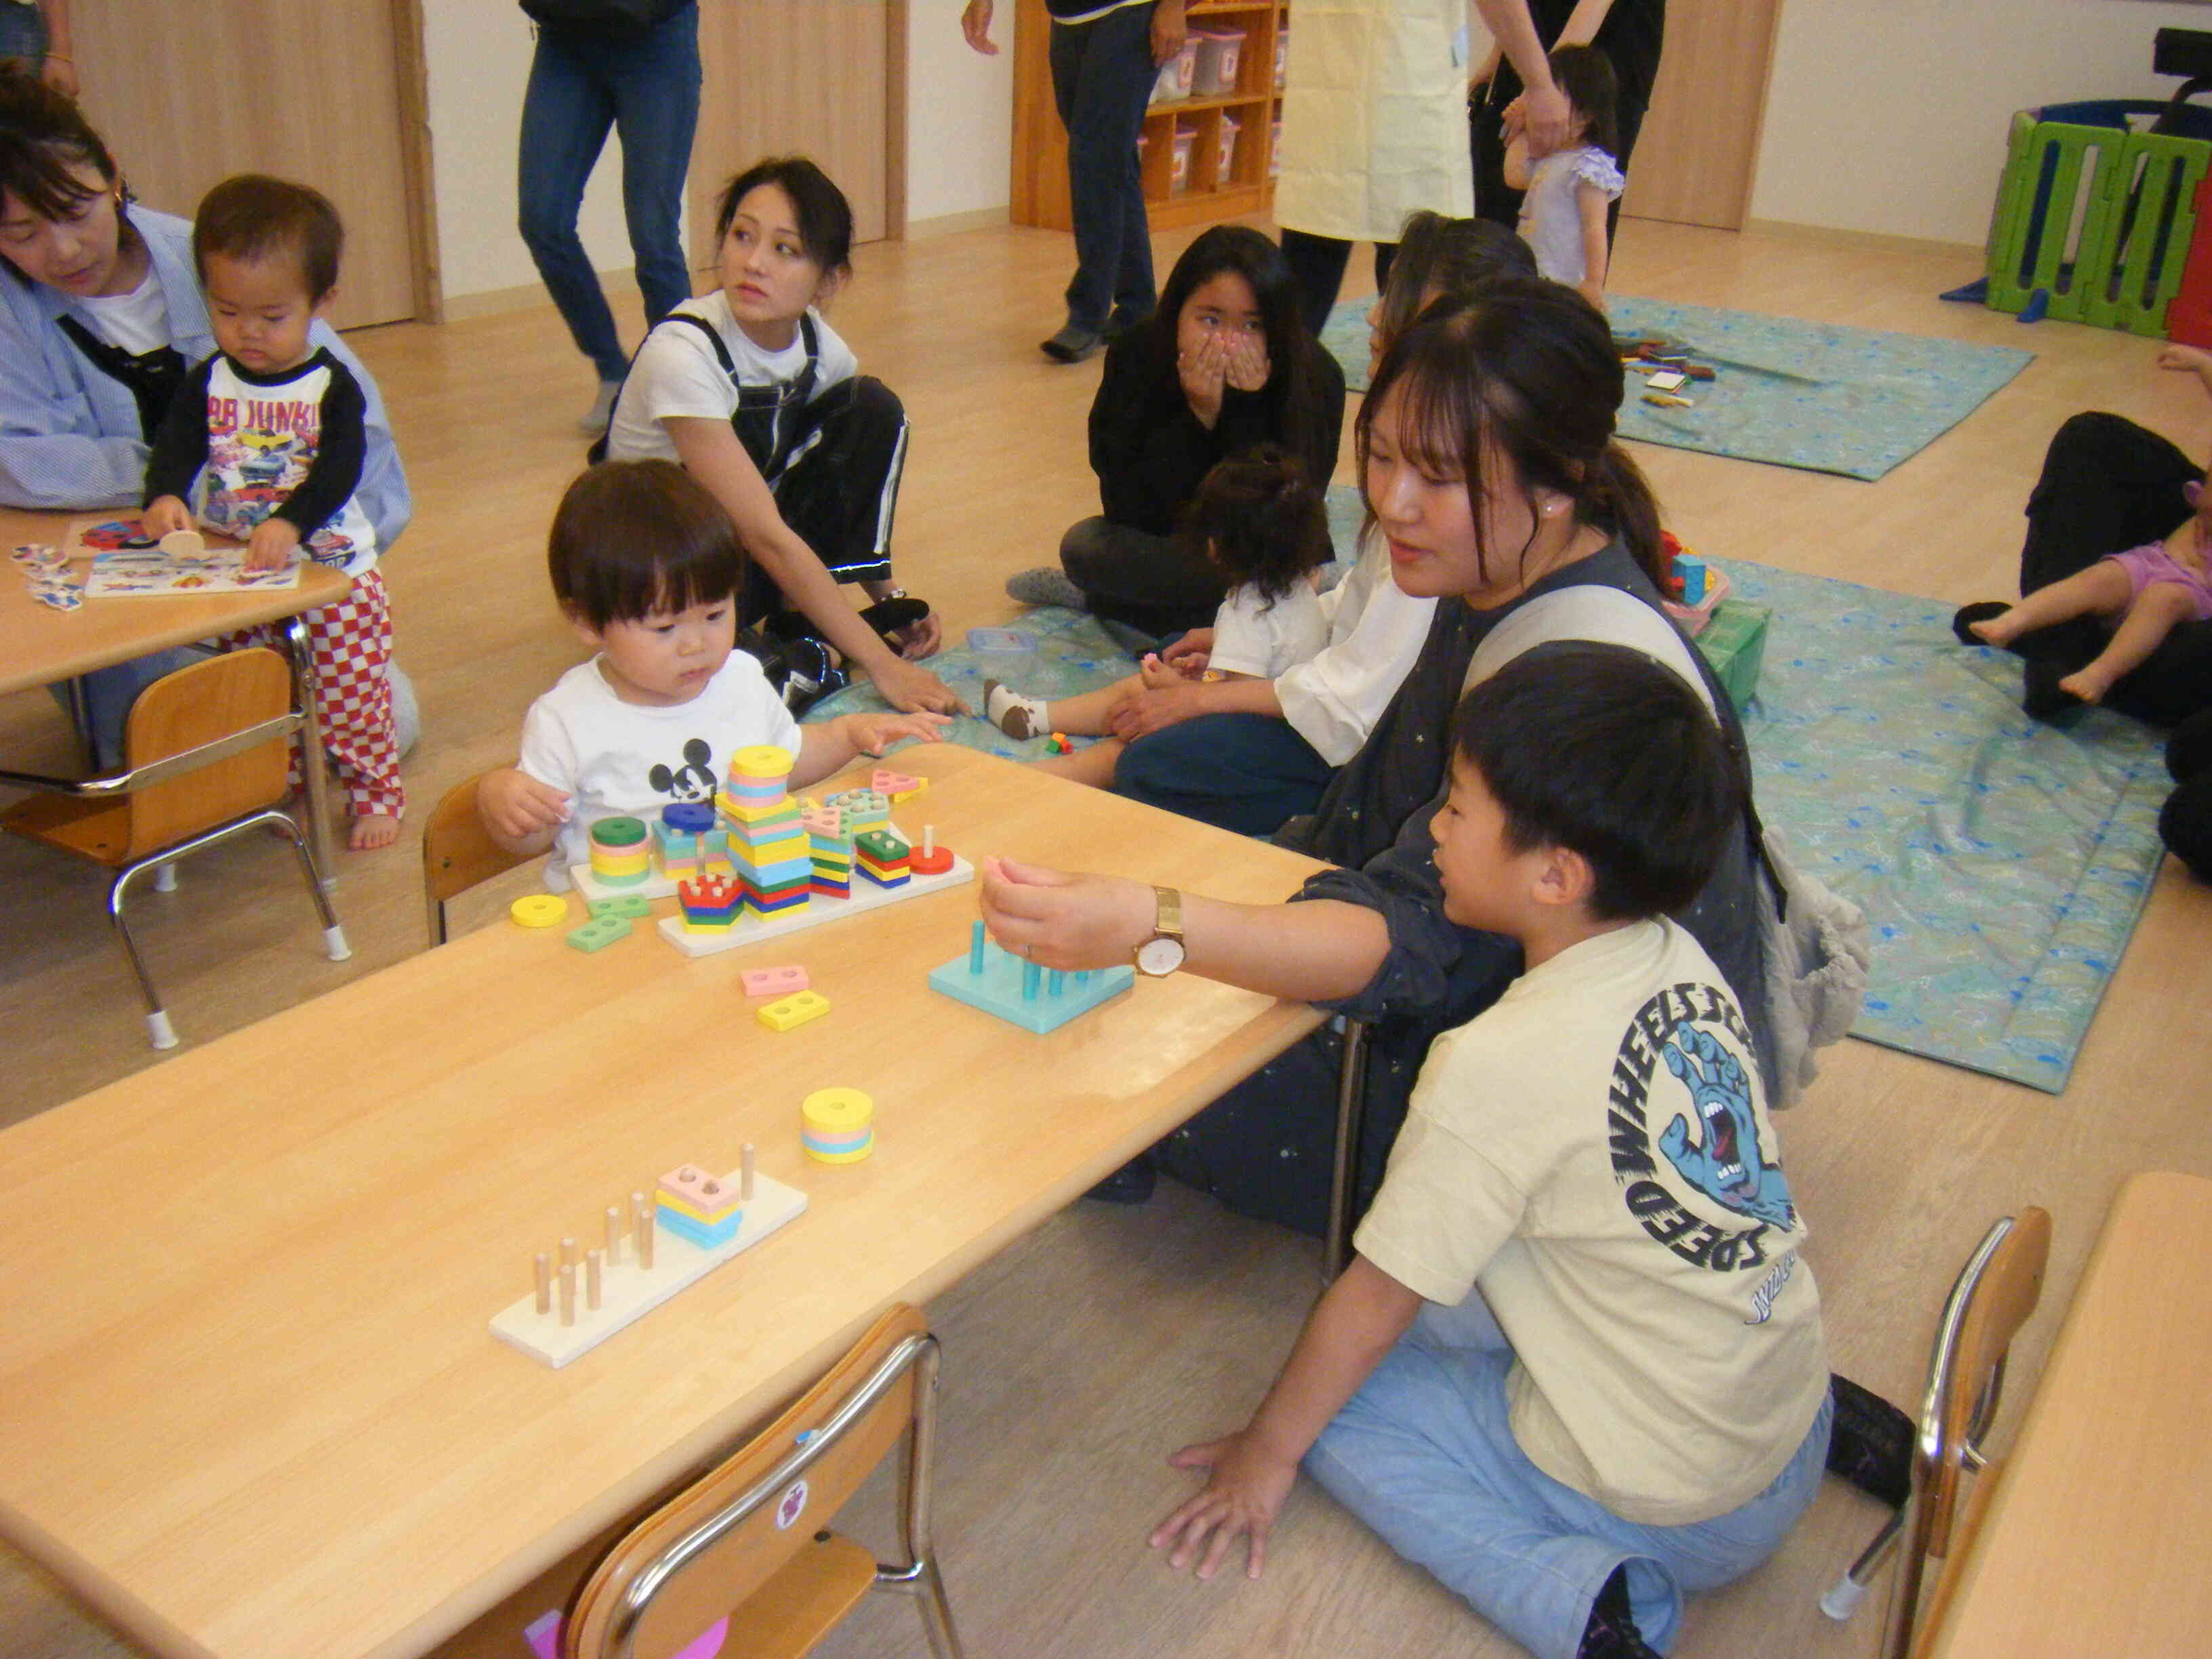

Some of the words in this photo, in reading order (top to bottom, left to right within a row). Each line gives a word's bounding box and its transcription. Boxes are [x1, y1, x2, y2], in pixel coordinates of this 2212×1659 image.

[207, 396, 239, 432] AR
[244, 399, 321, 432] JUNKI
[1607, 982, 1698, 1187] WHEELS
[1625, 1180, 1769, 1272] SPEED
